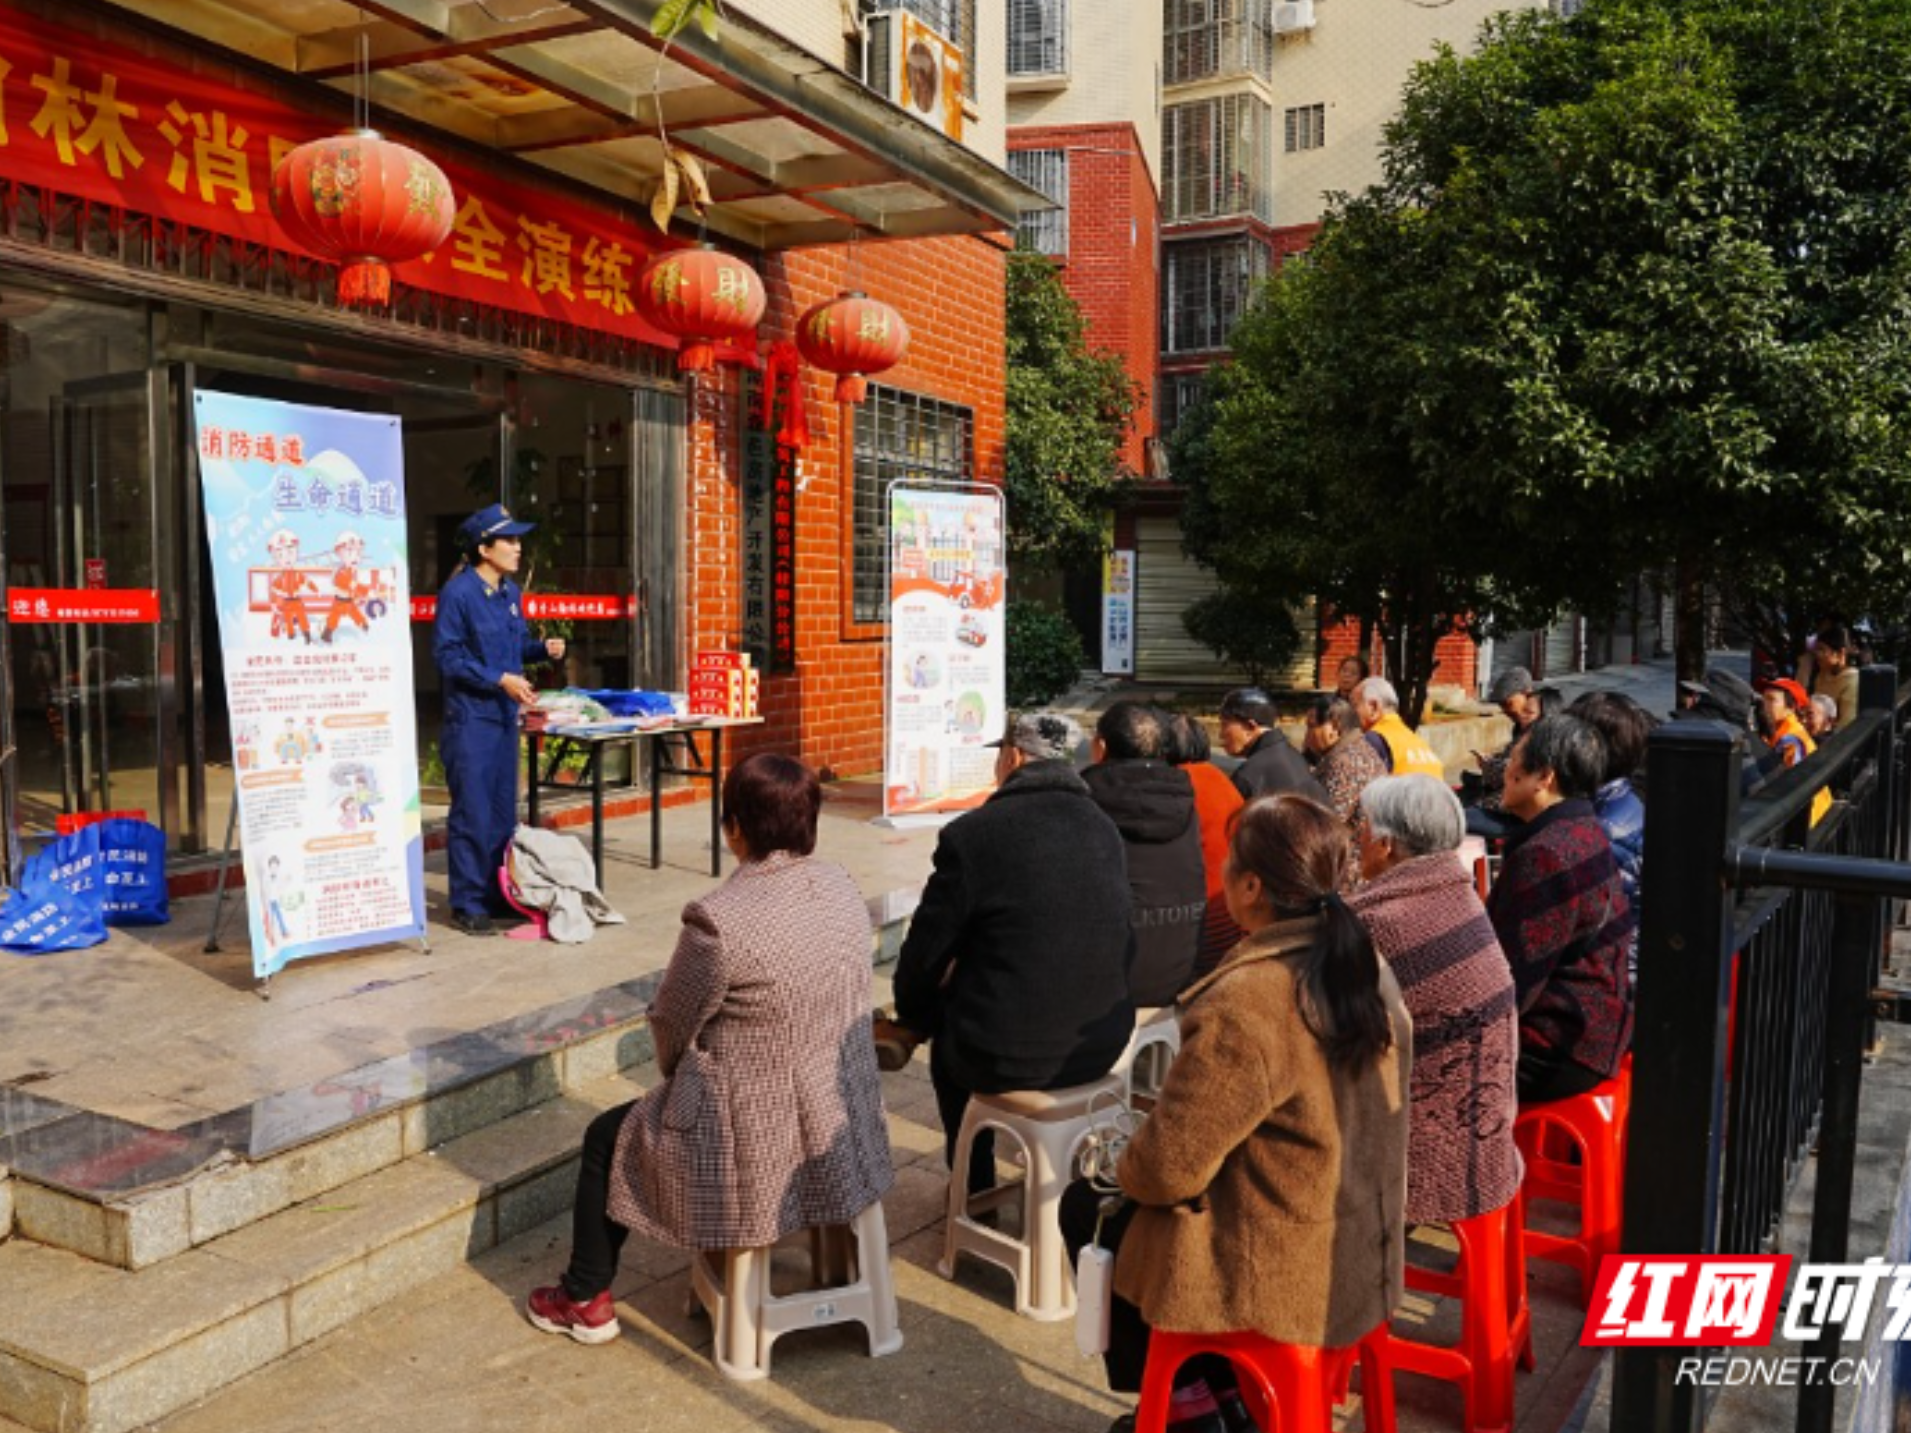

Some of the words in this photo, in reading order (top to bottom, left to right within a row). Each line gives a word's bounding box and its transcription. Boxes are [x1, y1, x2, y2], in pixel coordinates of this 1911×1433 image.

[200, 426, 306, 467] 消防通道
[275, 474, 397, 517] 生命通道
